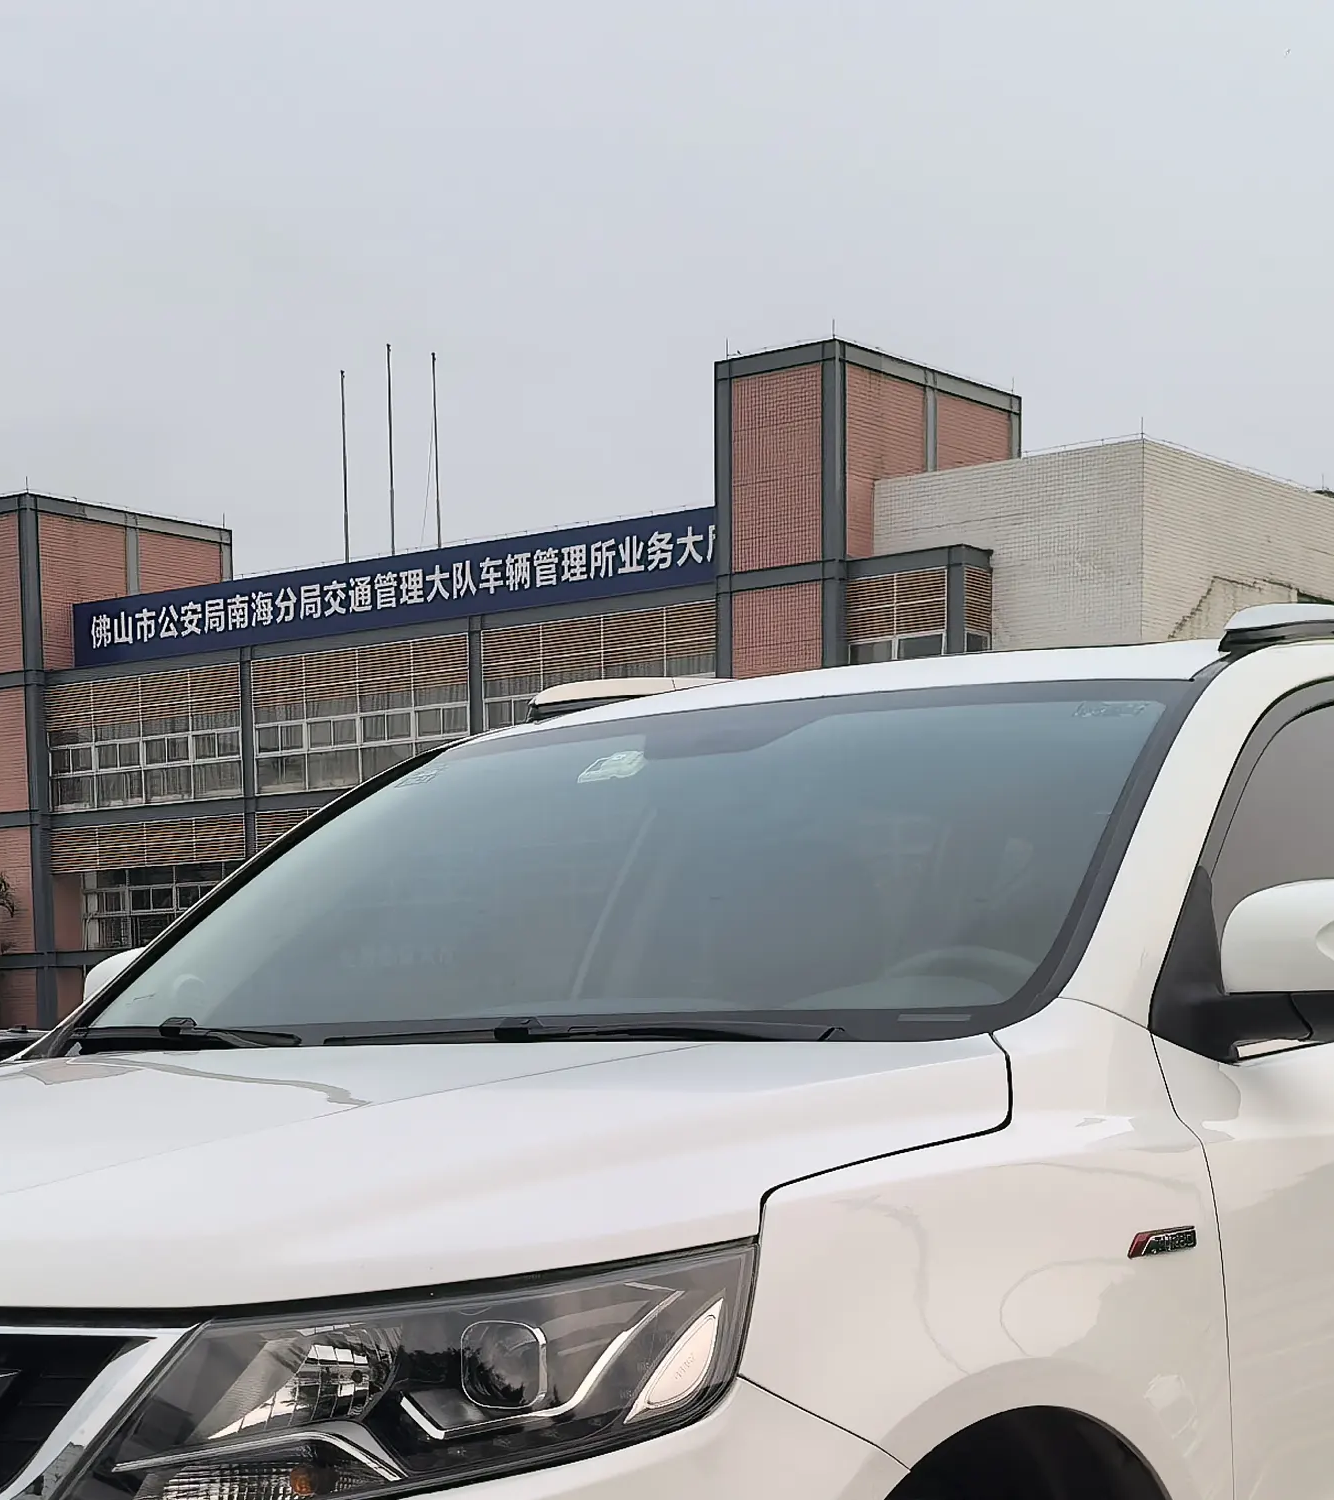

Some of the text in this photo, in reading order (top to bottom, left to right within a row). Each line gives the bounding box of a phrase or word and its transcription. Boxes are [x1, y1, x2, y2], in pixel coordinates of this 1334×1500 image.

[91, 525, 716, 649] 佛山市公安局南海分局交通管理大队车辆管理所业务大
